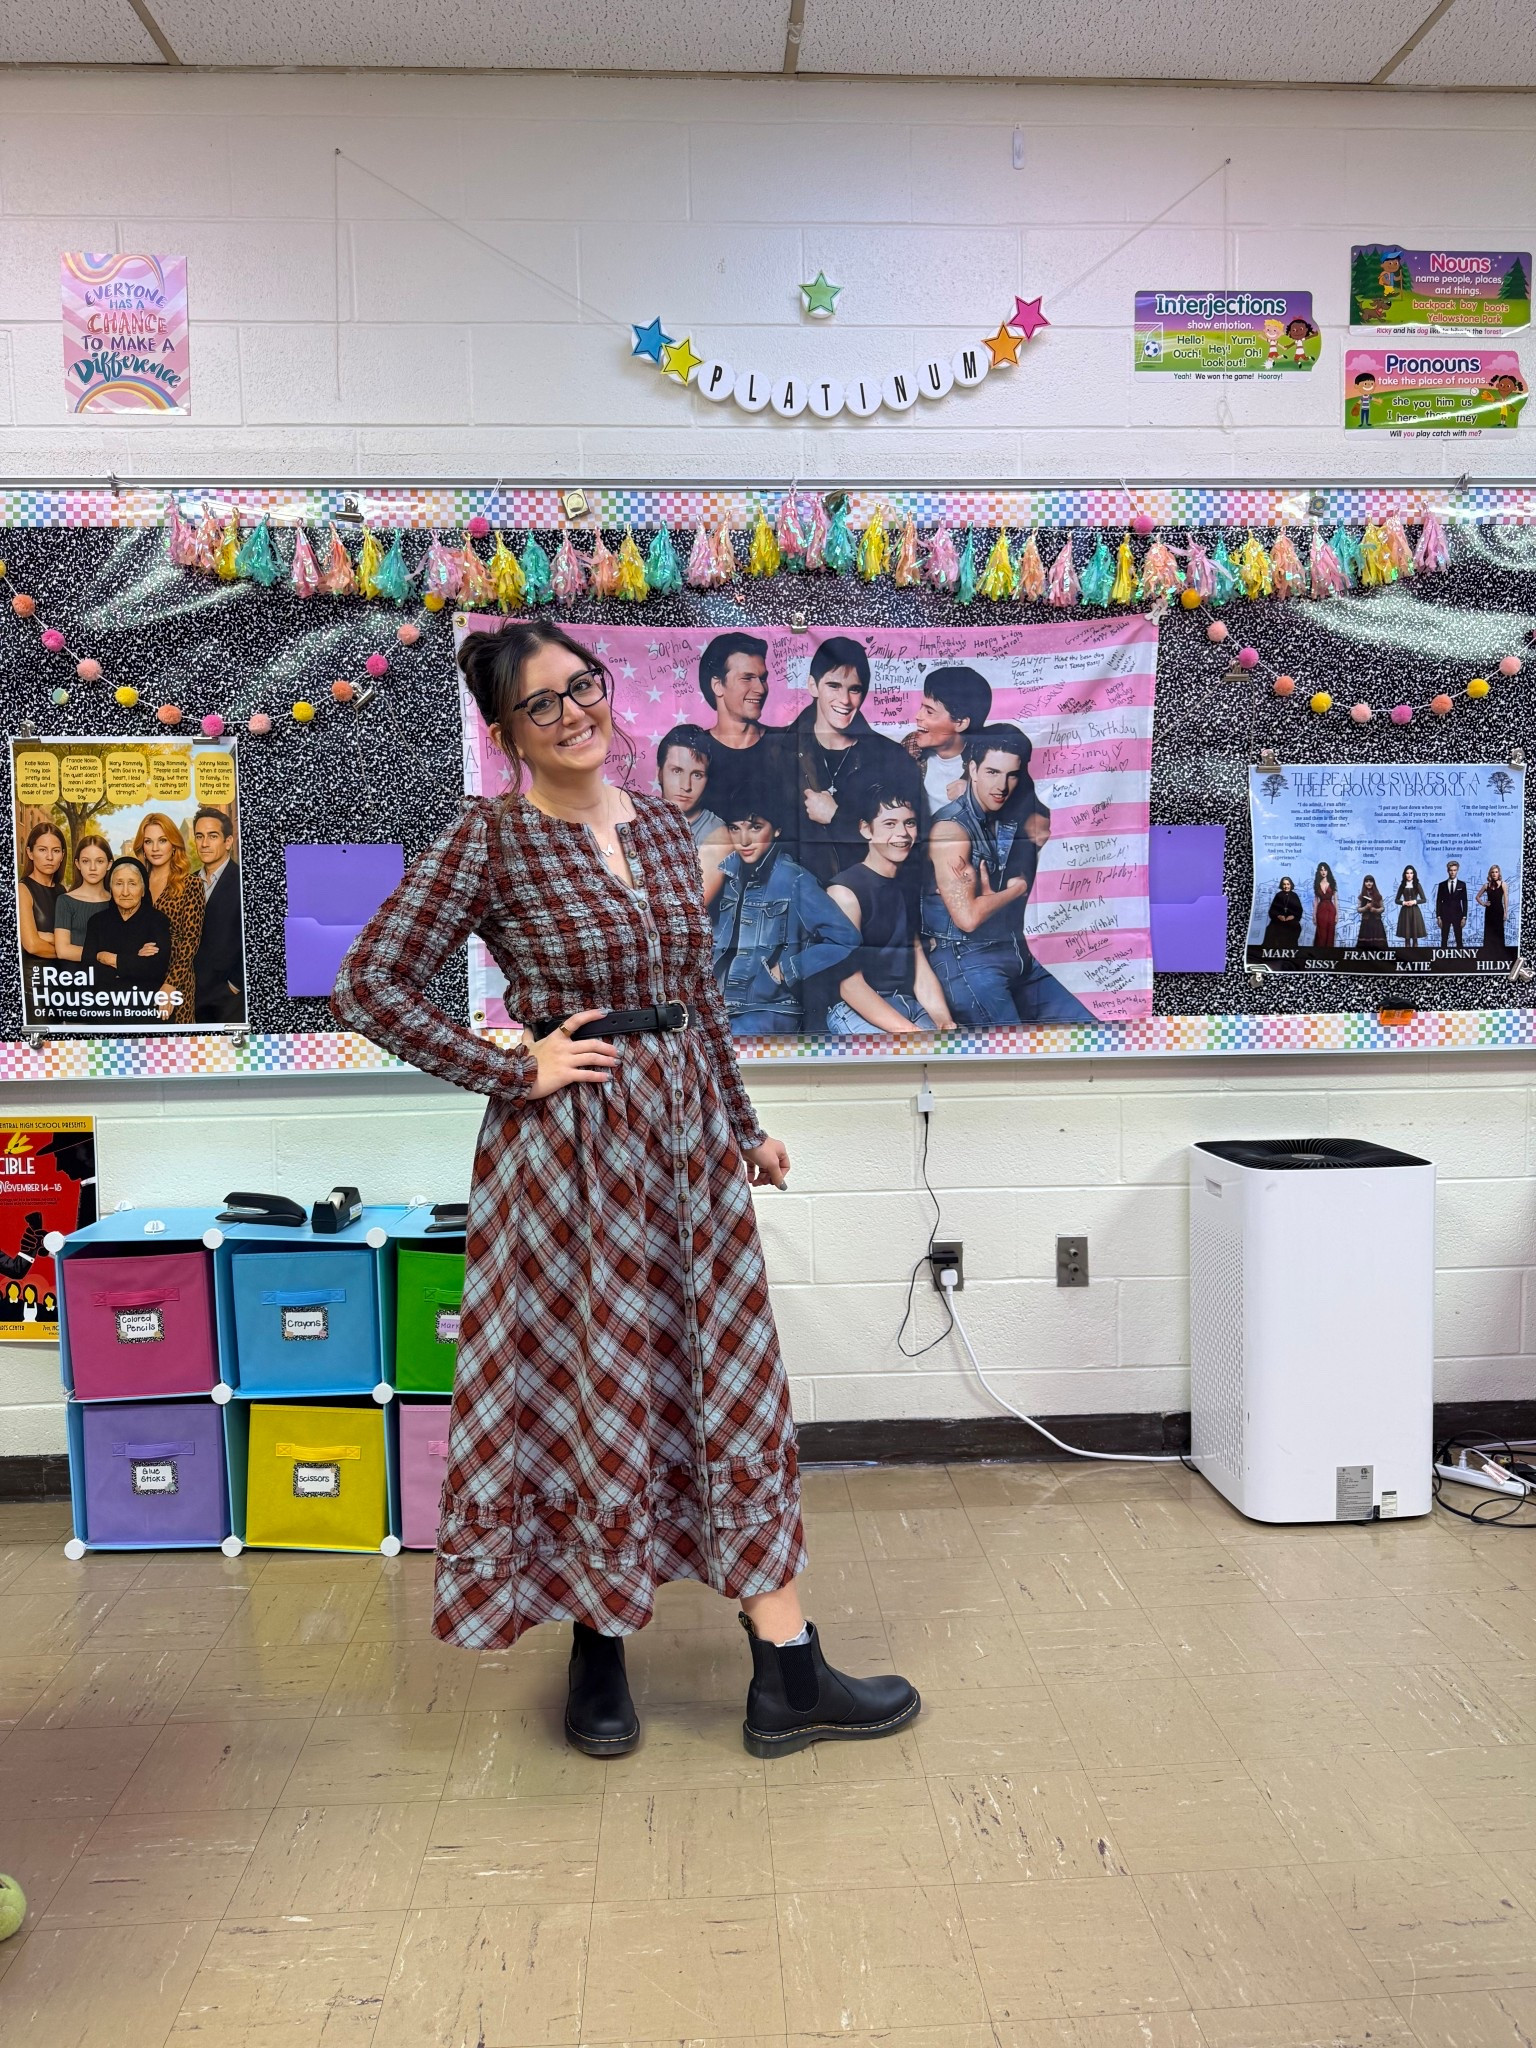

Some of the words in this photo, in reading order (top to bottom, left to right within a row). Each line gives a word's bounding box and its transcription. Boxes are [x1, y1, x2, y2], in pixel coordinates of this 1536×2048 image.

[1430, 253, 1491, 273] Nouns
[1415, 275, 1440, 283] name
[1442, 275, 1472, 285] people,
[1475, 275, 1504, 286] places,
[85, 282, 168, 308] EVERYONE
[1435, 286, 1451, 295] and
[1454, 286, 1482, 297] things.
[109, 299, 132, 310] HAS
[136, 299, 145, 310] A
[1156, 295, 1286, 318] Interjections
[1413, 299, 1456, 310] backpack
[1460, 300, 1478, 311] boy
[1484, 302, 1509, 312] boots
[87, 311, 168, 335] CHANCE
[1187, 320, 1211, 330] show
[1214, 320, 1254, 330] emotion.
[1428, 314, 1480, 323] Yellowstone
[1482, 314, 1502, 324] Park
[1376, 327, 1391, 335] Ricky
[1417, 327, 1429, 336] dog
[81, 335, 103, 351] TO
[111, 335, 156, 352] MAKE
[162, 338, 175, 352] A
[1177, 336, 1204, 344] Hello!
[1231, 336, 1256, 345] Yum!
[1173, 350, 1201, 359] Ouch!
[1209, 345, 1231, 356] Hey!
[1245, 349, 1262, 357] Oh!
[1202, 358, 1224, 367] Look
[1225, 358, 1246, 367] out!
[1386, 355, 1480, 373] Pronouns
[68, 351, 181, 388] Difference
[709, 350, 978, 412] PLATINUM
[1234, 373, 1254, 381] game!
[1258, 373, 1283, 381] Hooray!
[1378, 376, 1399, 385] take
[1401, 376, 1416, 385] the
[1419, 376, 1443, 388] place
[1446, 376, 1456, 385] of
[1392, 396, 1409, 406] she
[1414, 400, 1430, 409] you
[1436, 397, 1454, 406] him
[1461, 399, 1472, 407] us
[1416, 430, 1431, 438] play
[974, 637, 998, 649] Happy
[648, 639, 693, 661] Sophia
[867, 641, 896, 667] Emily
[897, 645, 908, 662] P
[1091, 653, 1105, 661] day
[874, 660, 901, 675] HAPPY
[874, 670, 918, 687] BIRTHDAY!
[874, 683, 901, 696] Happy
[1048, 721, 1083, 750] Happy
[1088, 715, 1138, 741] Birthday
[1042, 749, 1069, 764] Mrs
[1046, 763, 1065, 776] Lots
[1078, 763, 1095, 772] love
[1291, 772, 1318, 786] THE
[1321, 772, 1354, 786] REAL
[1361, 772, 1445, 786] HOUSWIVES
[1448, 772, 1467, 785] OF
[1471, 772, 1481, 785] A
[1295, 784, 1328, 797] TREE
[1332, 784, 1386, 797] GROWS
[1405, 783, 1478, 797] BROOKLYN
[1062, 841, 1090, 853] Happy
[1059, 872, 1091, 896] Happy
[1025, 921, 1049, 935] Happy
[1065, 927, 1090, 949] Happy
[1262, 949, 1299, 959] MARY
[1343, 951, 1397, 961] FRANCIE
[1430, 948, 1479, 962] JOHNNY
[1304, 959, 1339, 970] SISSY
[1396, 961, 1432, 971] KATIE
[1476, 960, 1513, 971] HILDY
[31, 965, 40, 987] The
[42, 966, 94, 987] Real
[1084, 964, 1109, 981] Happy
[32, 985, 184, 1007] Housewives
[1092, 1000, 1115, 1009] Happy
[34, 1008, 46, 1017] Of
[48, 1008, 56, 1017] A
[57, 1008, 78, 1017] Tree
[79, 1008, 111, 1018] Grows
[112, 1008, 122, 1017] In
[124, 1008, 168, 1019] Brooklyn
[0, 1157, 36, 1175] CIBLE
[122, 1316, 152, 1324] Colored
[287, 1319, 321, 1330] Crayons
[126, 1323, 156, 1332] Pencils
[140, 1475, 166, 1483] Sticks
[298, 1475, 330, 1483] Scissors
